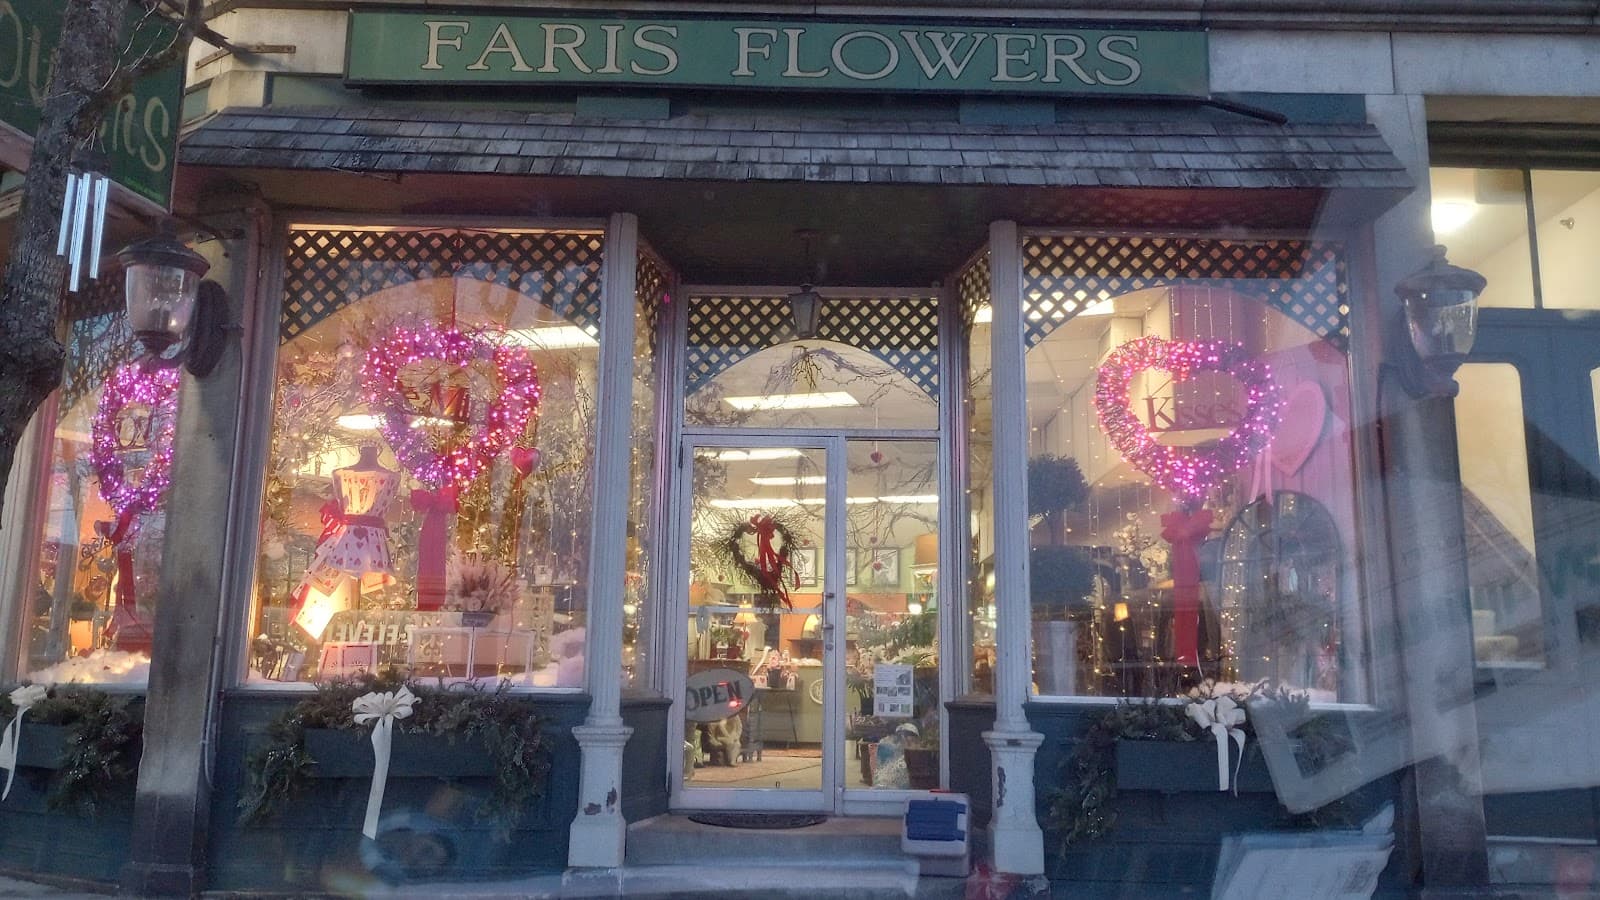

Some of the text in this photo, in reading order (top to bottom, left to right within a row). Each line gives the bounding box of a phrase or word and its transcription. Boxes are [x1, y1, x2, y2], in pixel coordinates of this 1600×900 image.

[420, 20, 1143, 86] FARIS FLOWERS
[686, 680, 743, 711] OPEN
